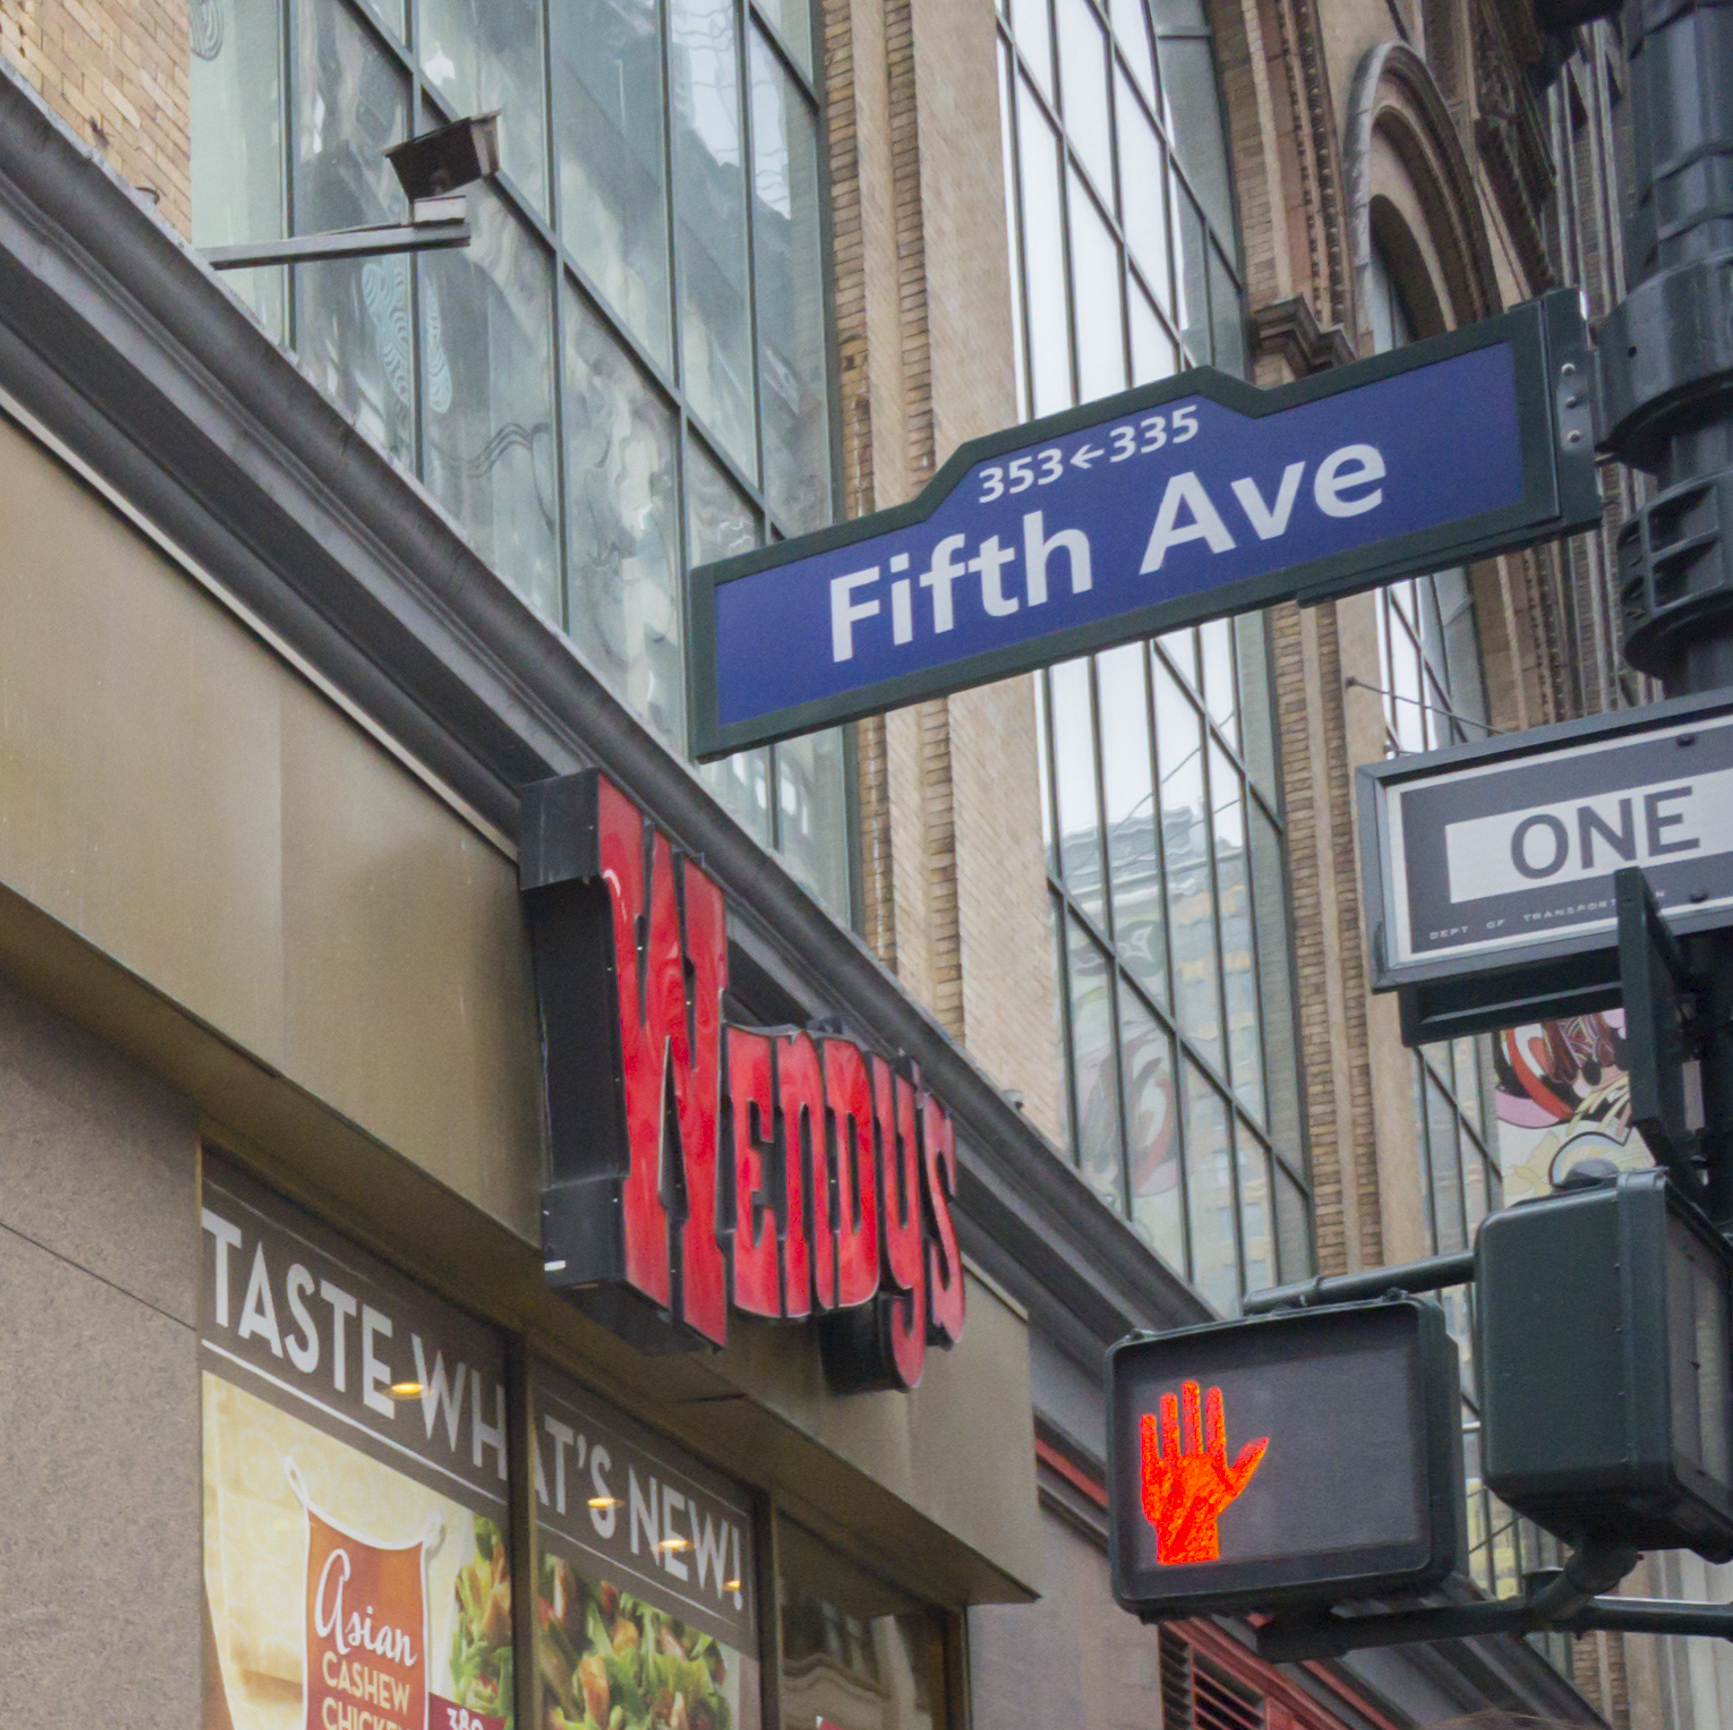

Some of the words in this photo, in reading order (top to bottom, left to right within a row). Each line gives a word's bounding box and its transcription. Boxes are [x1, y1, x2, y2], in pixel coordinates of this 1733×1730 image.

[978, 448, 1064, 503] 353
[1108, 405, 1200, 462] 335
[830, 509, 1093, 662] Fifth
[1139, 441, 1387, 575] Ave
[1510, 785, 1701, 880] ONE
[201, 1206, 396, 1420] TASTE
[628, 1463, 743, 1611] NEW!
[314, 1548, 418, 1667] Asian
[322, 1651, 410, 1715] CASHEW
